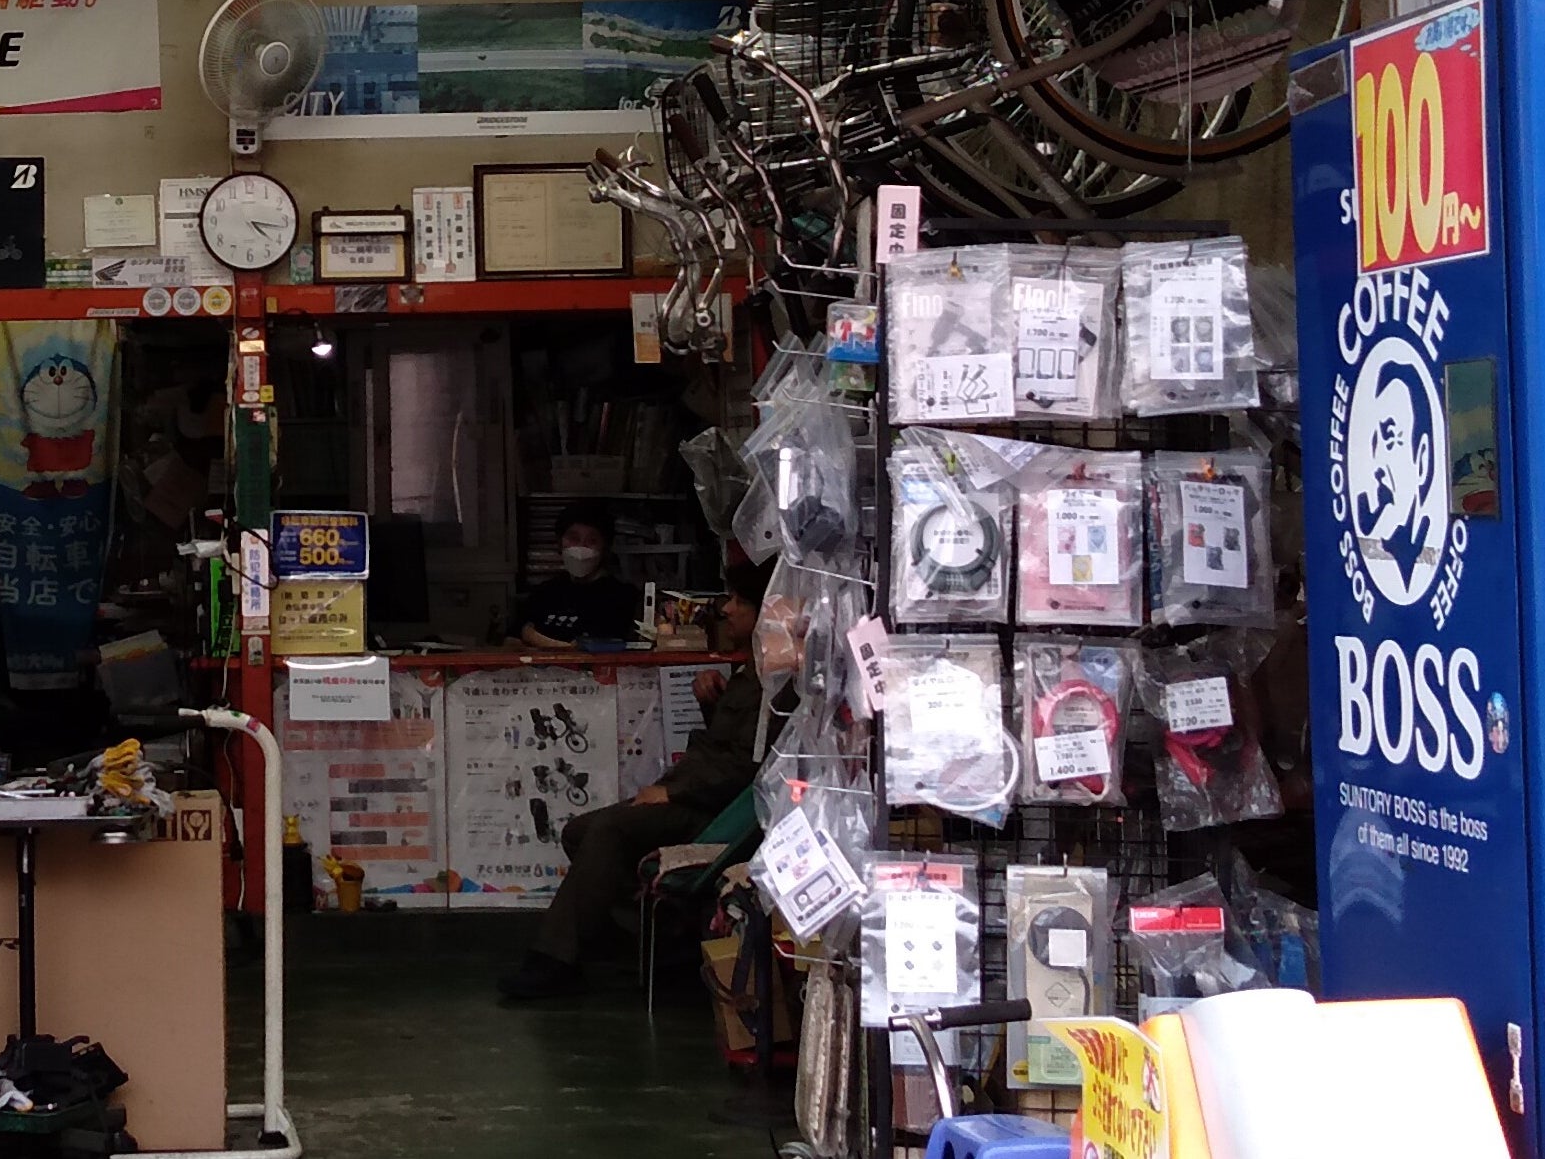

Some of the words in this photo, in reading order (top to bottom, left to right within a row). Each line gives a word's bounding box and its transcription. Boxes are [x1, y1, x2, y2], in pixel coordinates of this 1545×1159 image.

[283, 91, 345, 117] CITY
[1337, 266, 1451, 367] COFFEE
[1329, 374, 1351, 522] COFFEE
[299, 528, 341, 547] 660
[299, 547, 341, 566] 500
[1429, 514, 1470, 632] OFFEE
[1339, 530, 1376, 625] BOSS
[1333, 635, 1485, 781] BOSS
[1339, 782, 1392, 817] SUNTORY
[1394, 795, 1426, 826] BOSS
[1428, 803, 1438, 829] is
[1440, 806, 1457, 834] the
[1460, 811, 1488, 841] boss
[1358, 822, 1369, 843] of
[1369, 824, 1395, 850] them
[1397, 833, 1409, 856] all
[1411, 836, 1439, 865] since
[1442, 844, 1469, 873] 1992
